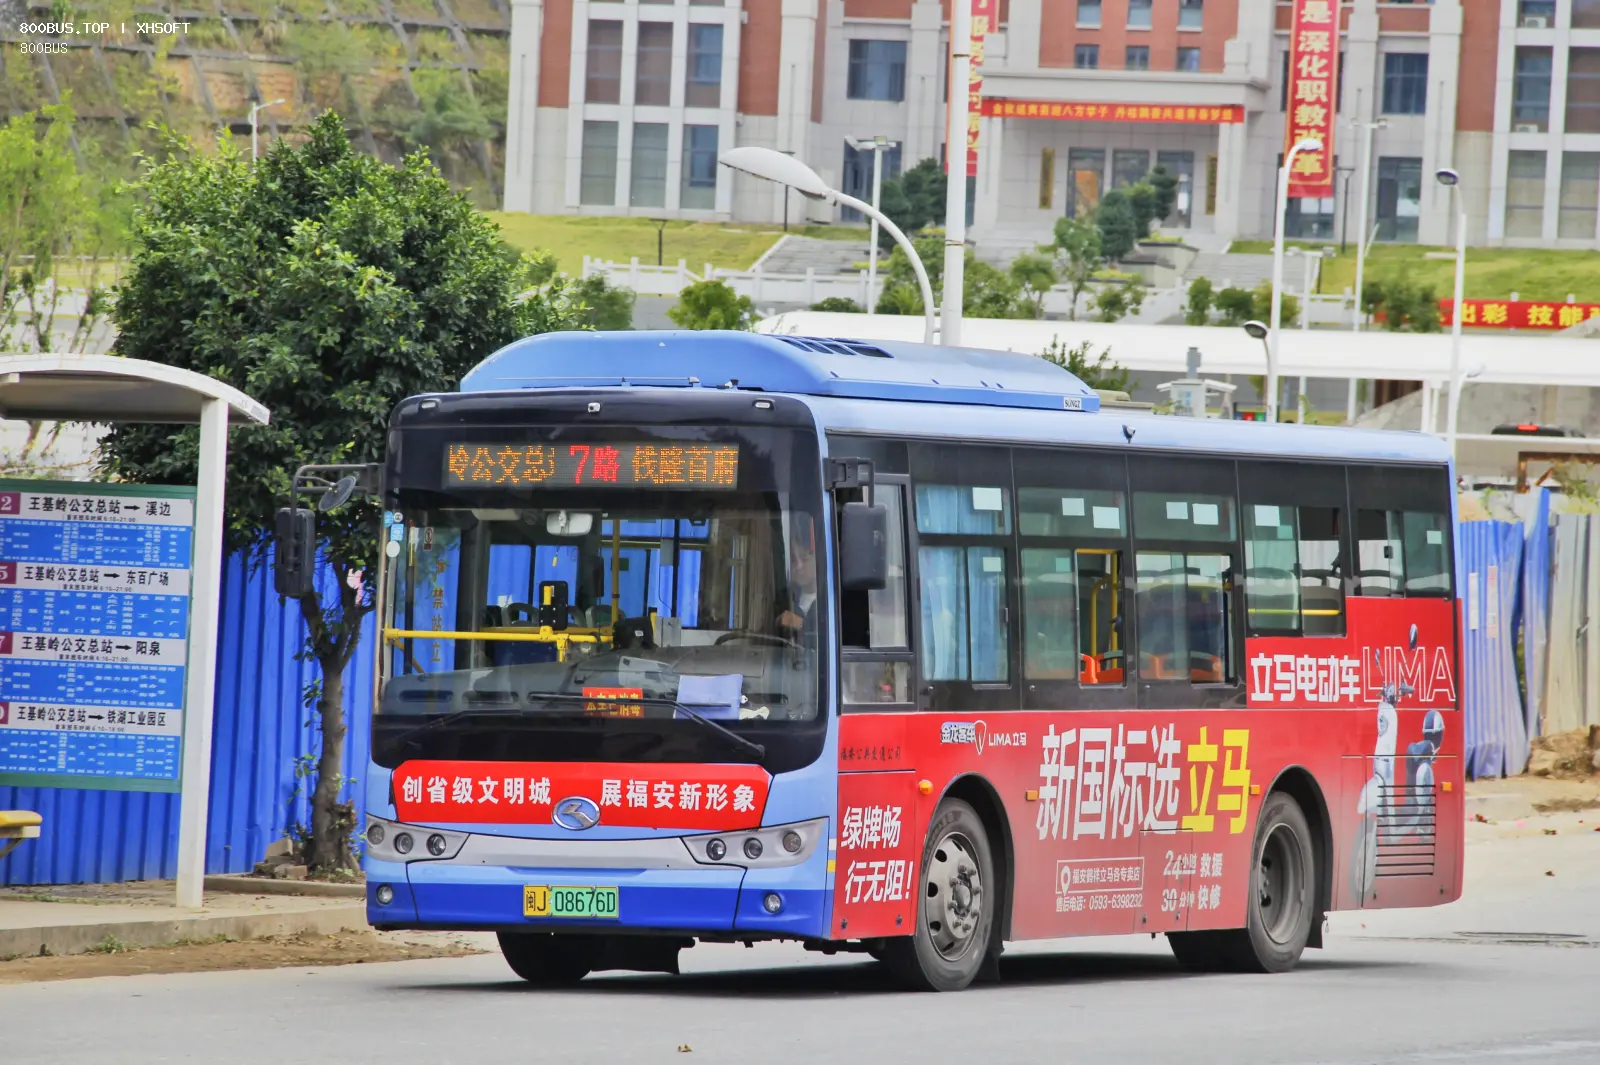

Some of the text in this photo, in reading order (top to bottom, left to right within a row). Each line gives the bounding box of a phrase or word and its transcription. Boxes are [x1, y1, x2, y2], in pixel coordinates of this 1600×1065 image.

[449, 445, 555, 483] 岭公交总
[569, 445, 620, 484] 7路
[28, 496, 121, 514] 王基岭公交总站
[145, 500, 171, 517] 溪边
[24, 566, 100, 583] 王基岭公交总站
[126, 570, 169, 586] 东百广场
[21, 636, 114, 653] 王基岭公交总站
[135, 640, 161, 656] 阳泉
[1250, 653, 1360, 702] 立马电动车
[17, 706, 87, 723] 王基岭公交总站
[107, 710, 167, 726] 铁湖工业园区
[939, 723, 976, 745] 金龙客车
[402, 776, 756, 813] 创省级文明城 展福安新形象
[841, 805, 902, 849] 绿牌畅
[1200, 852, 1223, 877] 救援
[845, 860, 914, 904] 行无阻！
[1197, 884, 1221, 910] 快修
